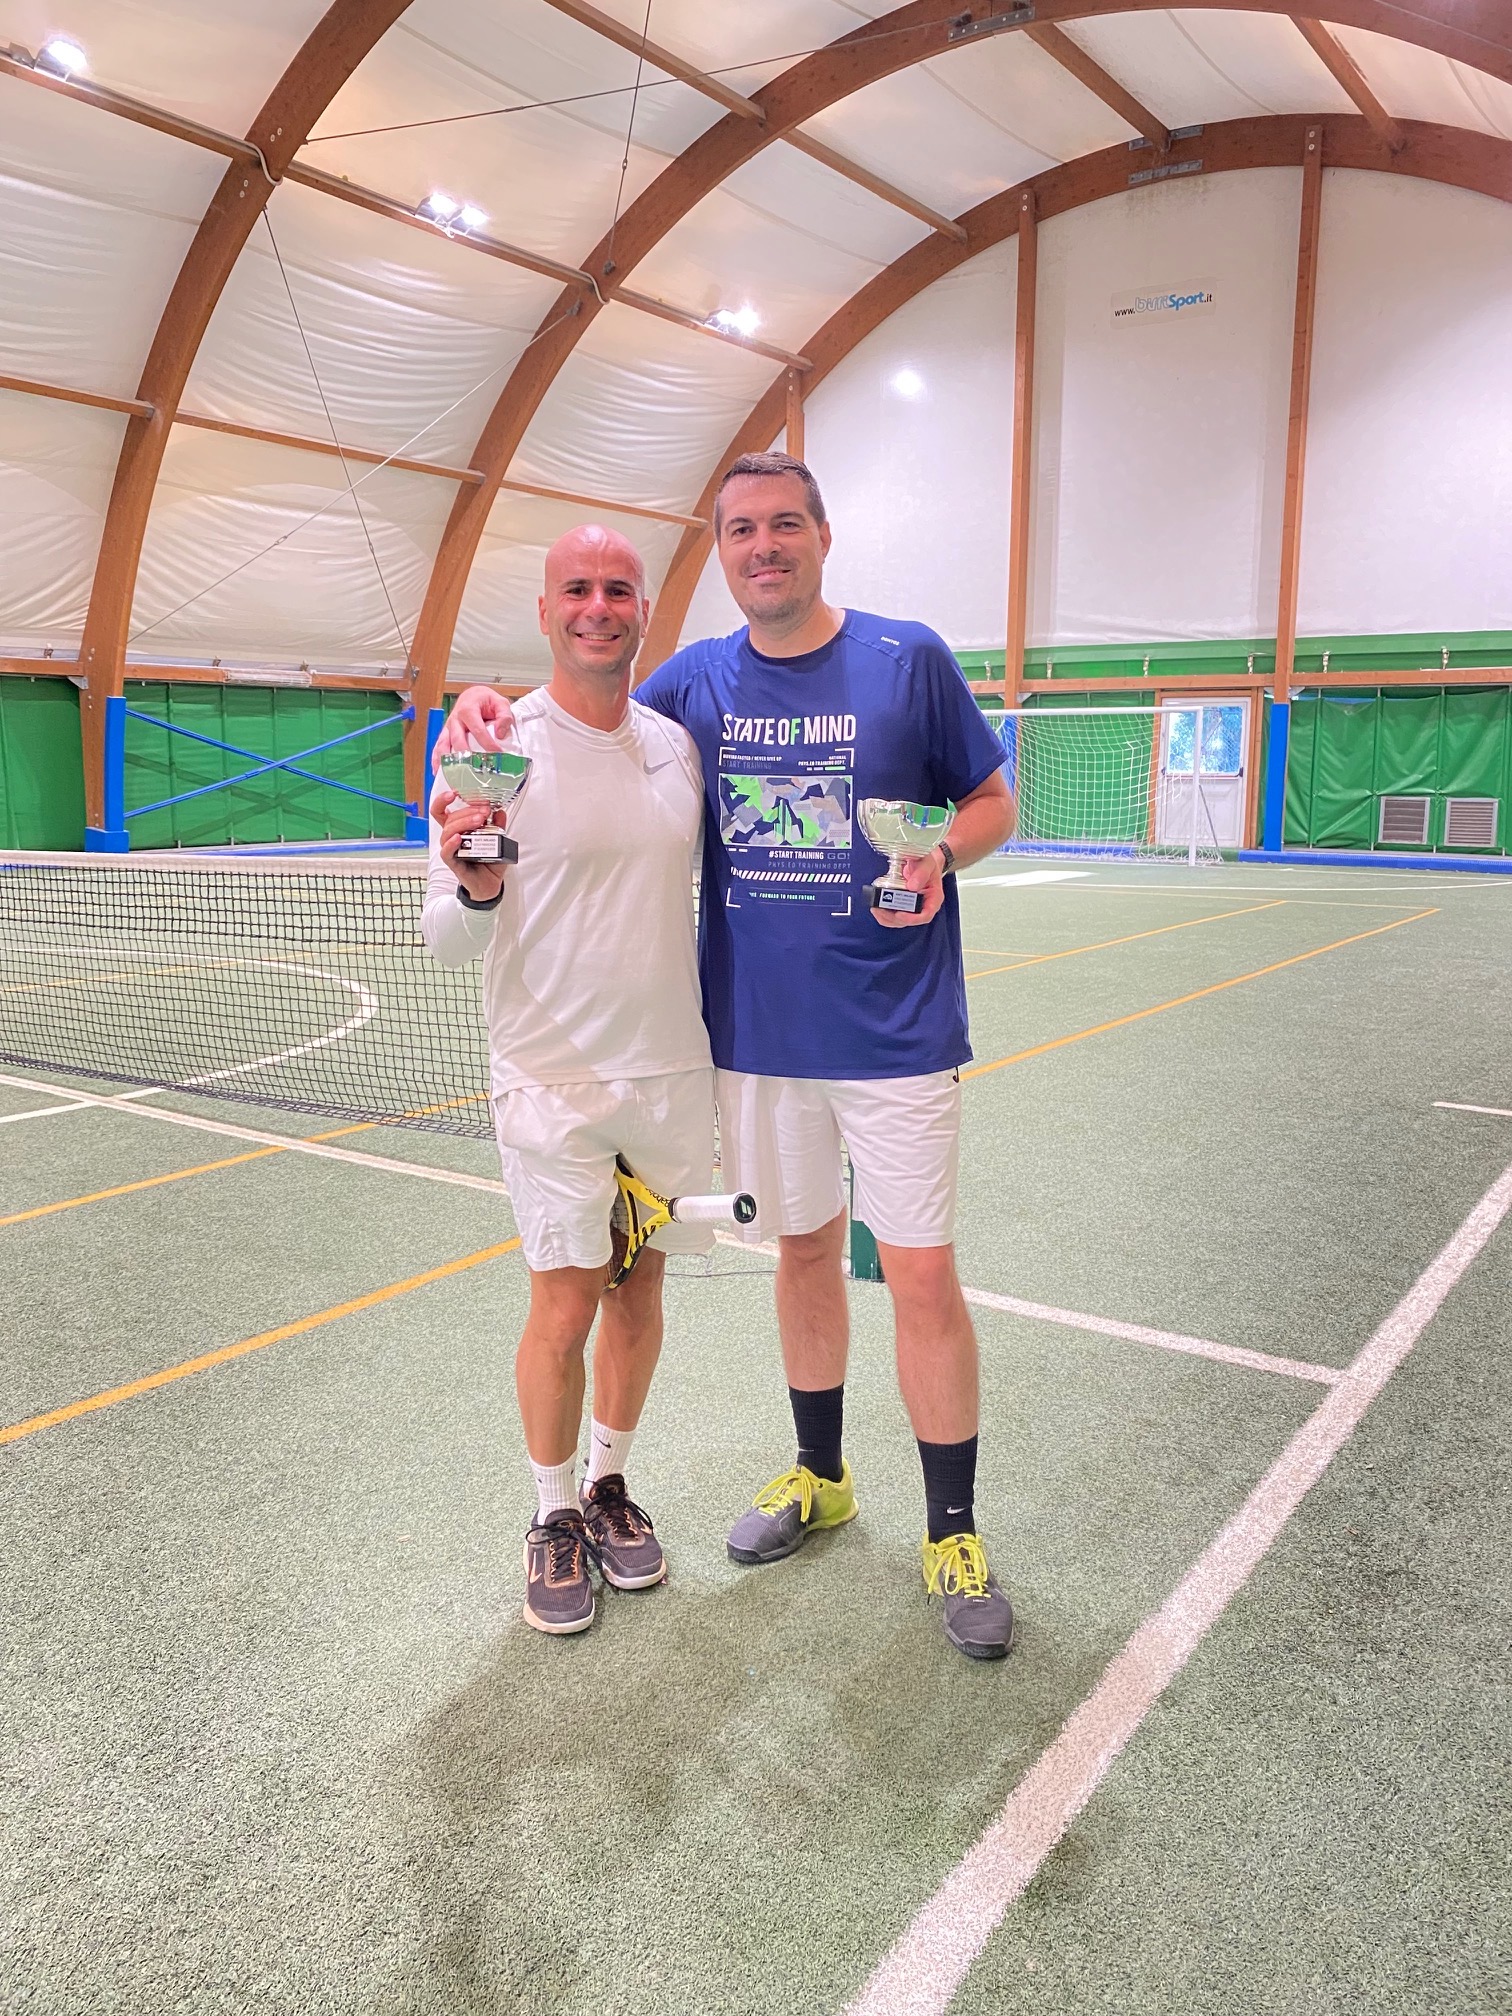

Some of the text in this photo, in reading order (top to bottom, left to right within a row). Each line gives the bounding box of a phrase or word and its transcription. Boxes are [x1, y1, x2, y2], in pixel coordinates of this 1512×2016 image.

[722, 713, 857, 746] STATE OF MIND
[768, 850, 794, 859] #START
[794, 851, 825, 860] TRAINING
[798, 862, 831, 870] TRAINING
